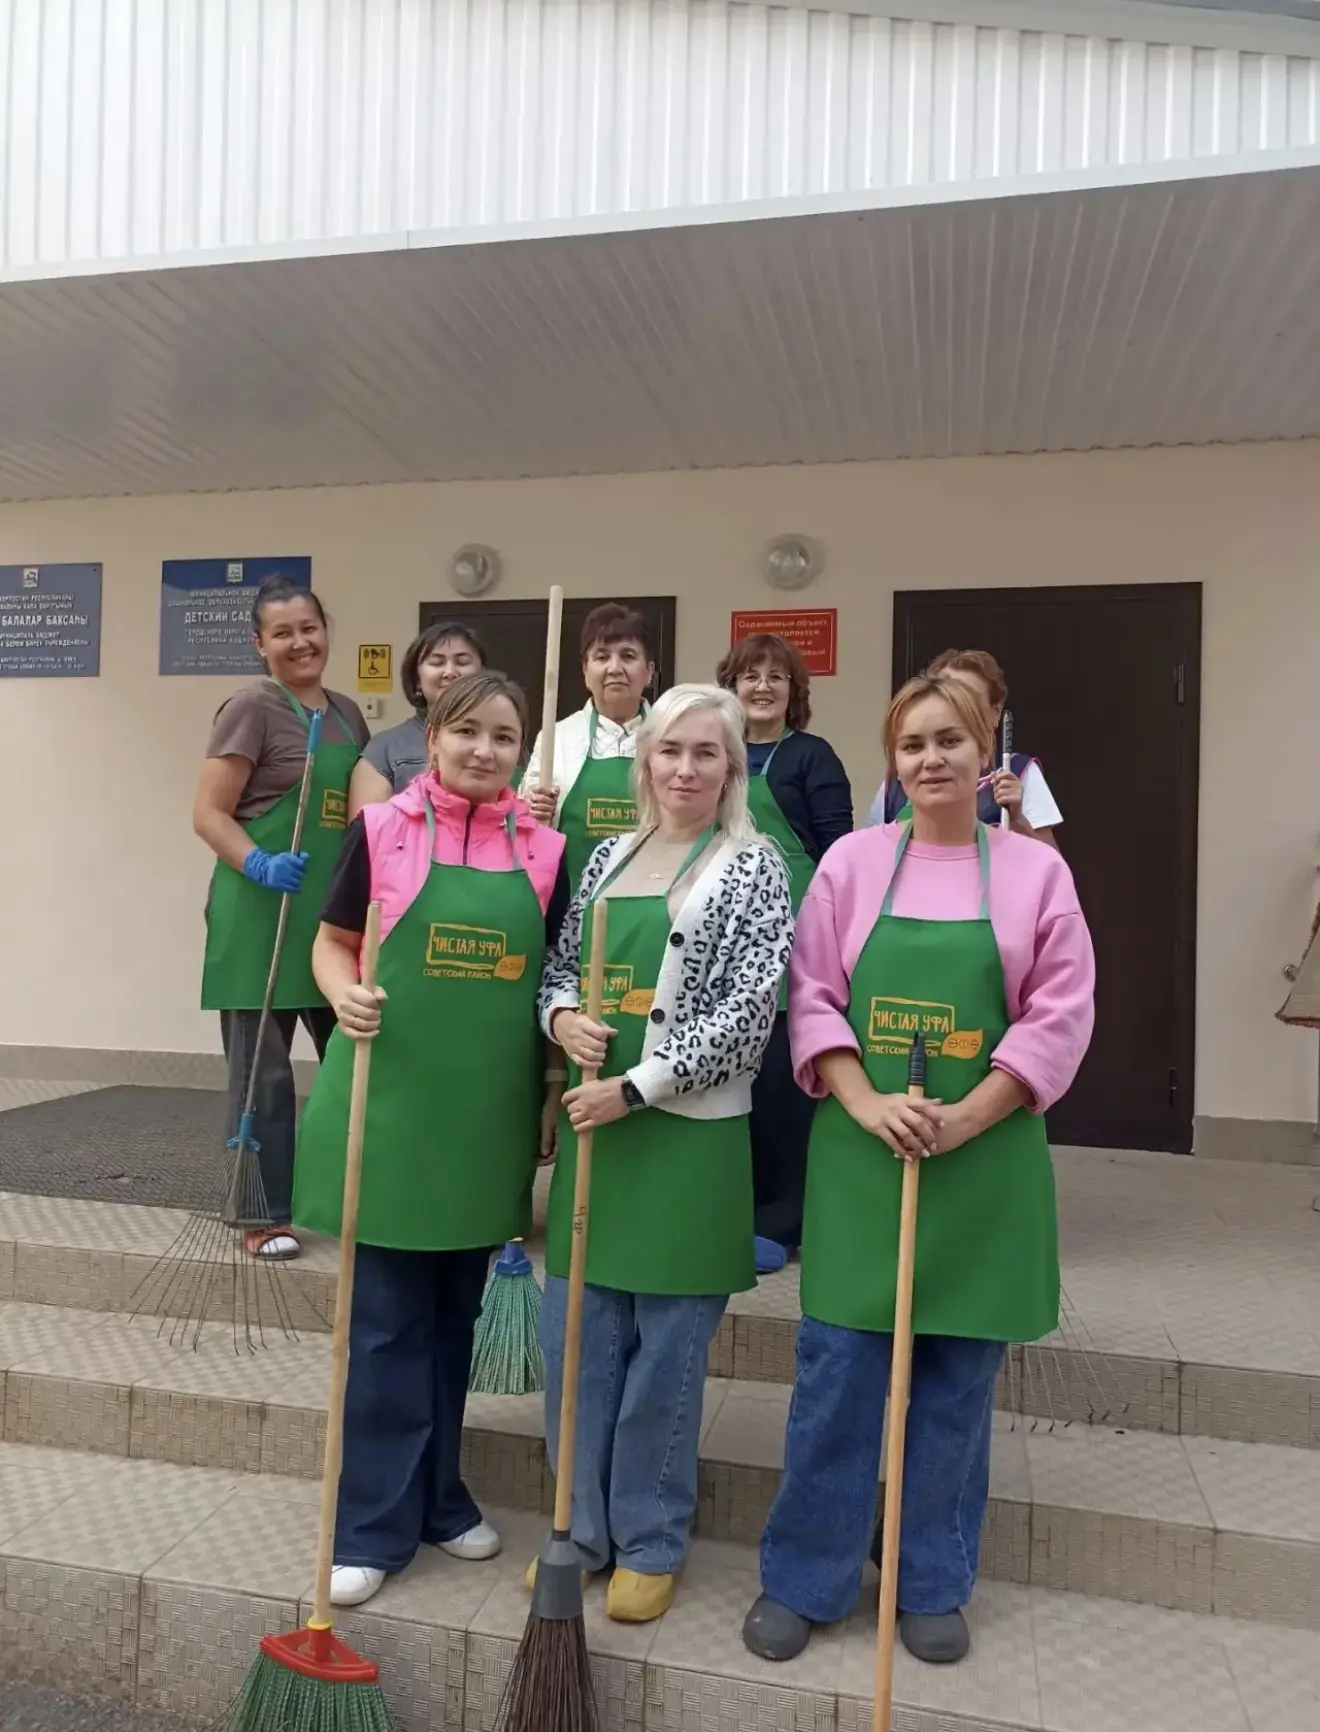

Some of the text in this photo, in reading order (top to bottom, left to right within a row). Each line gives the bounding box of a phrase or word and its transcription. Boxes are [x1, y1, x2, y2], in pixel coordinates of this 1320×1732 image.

[2, 614, 42, 627] БАЛАЛАР
[185, 611, 252, 624] ДЕТСКИЙ САД
[590, 807, 622, 820] ЧИСТАЯ
[432, 935, 502, 957] ЧИСТАЯ УФА
[423, 968, 466, 979] СОВЕТСКИЙ
[873, 1010, 949, 1033] ЧИСТАЯ УФА
[867, 1044, 909, 1055] СОВЕТСКИЙ
